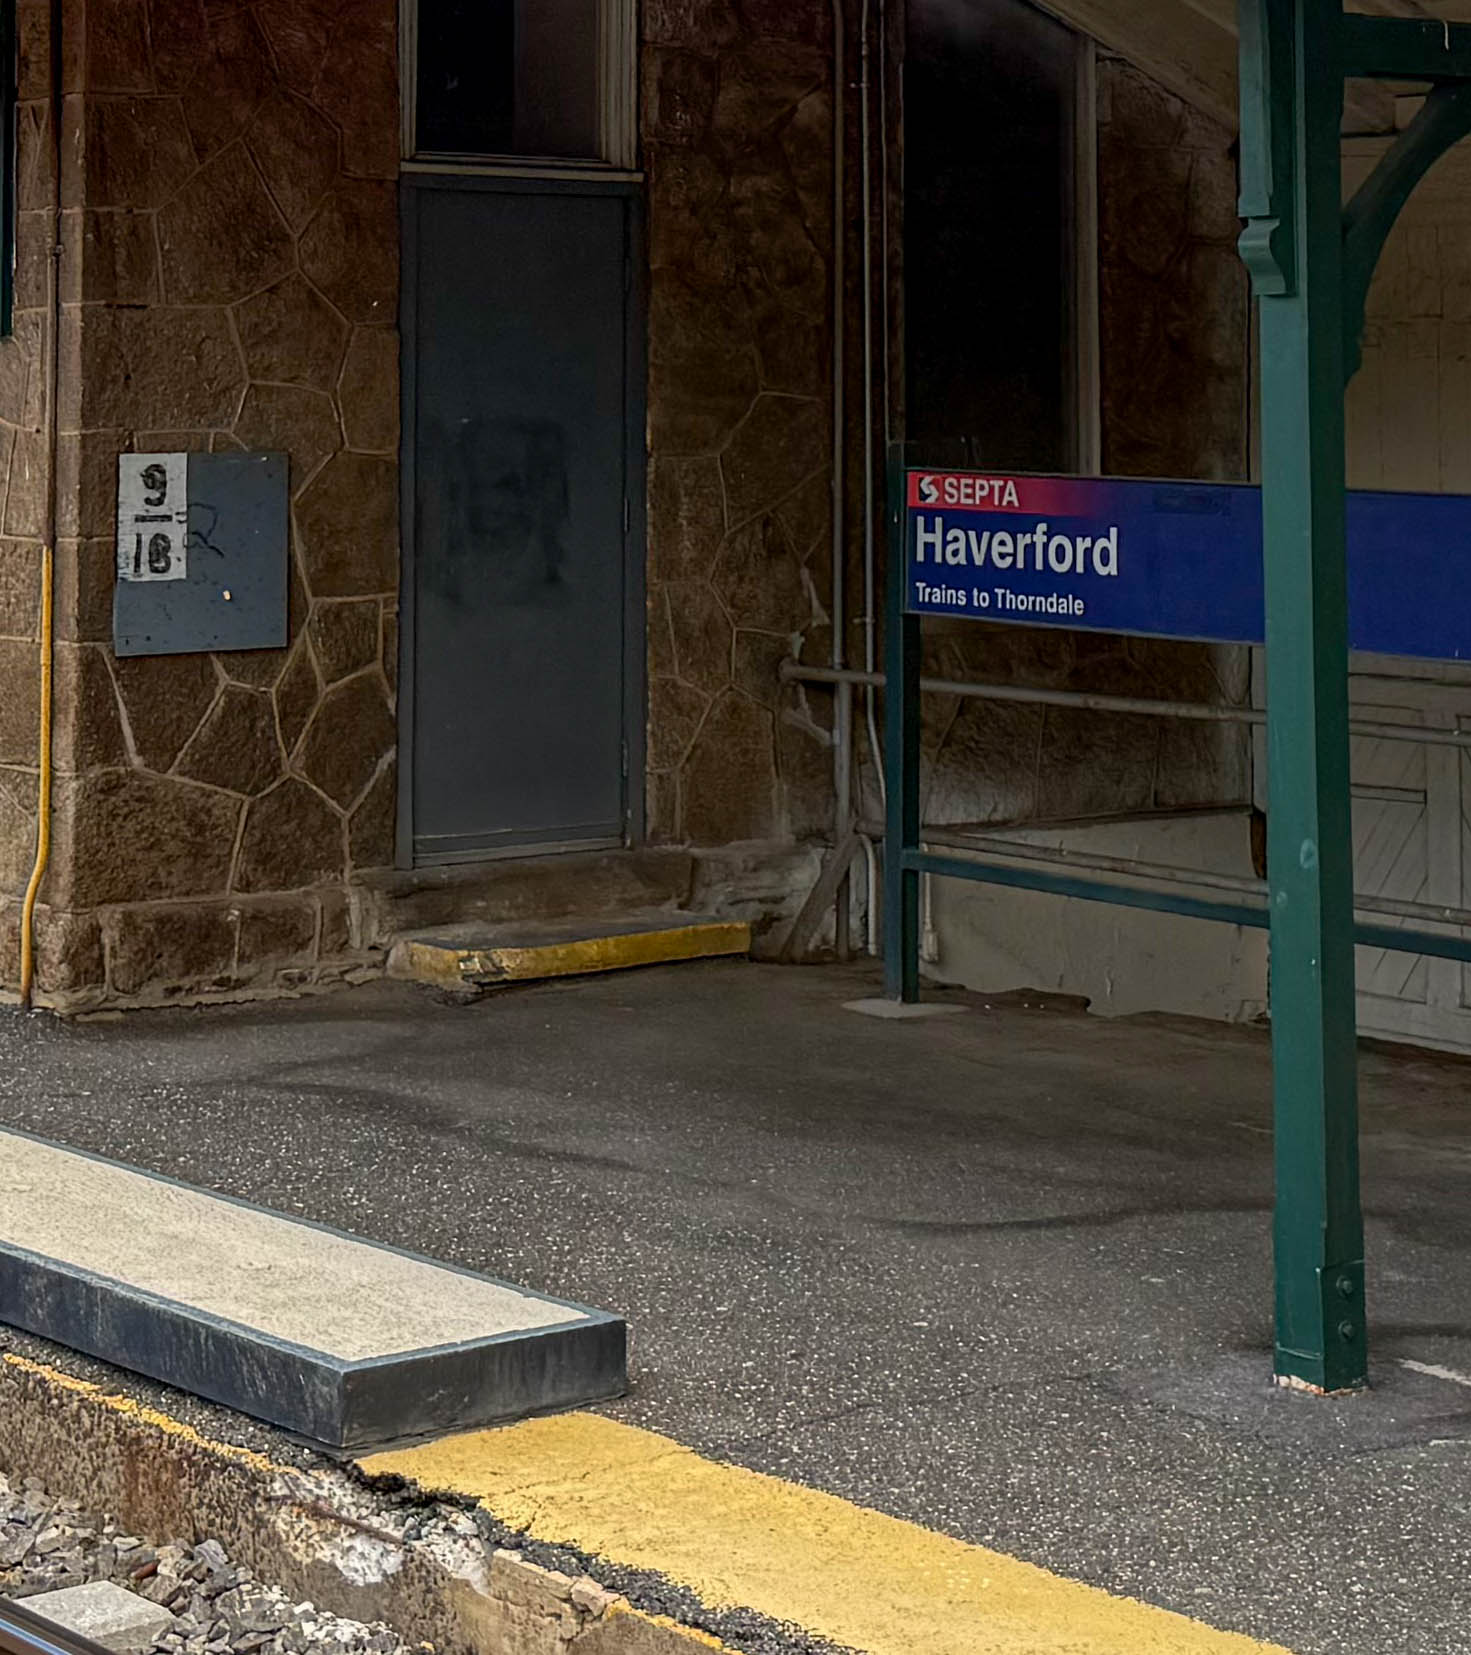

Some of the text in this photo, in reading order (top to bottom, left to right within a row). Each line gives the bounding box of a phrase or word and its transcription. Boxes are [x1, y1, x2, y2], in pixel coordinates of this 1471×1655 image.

[943, 477, 1020, 507] SEPTA
[915, 515, 1119, 577] Haverford
[915, 581, 1085, 616] Trains to Thorndale
